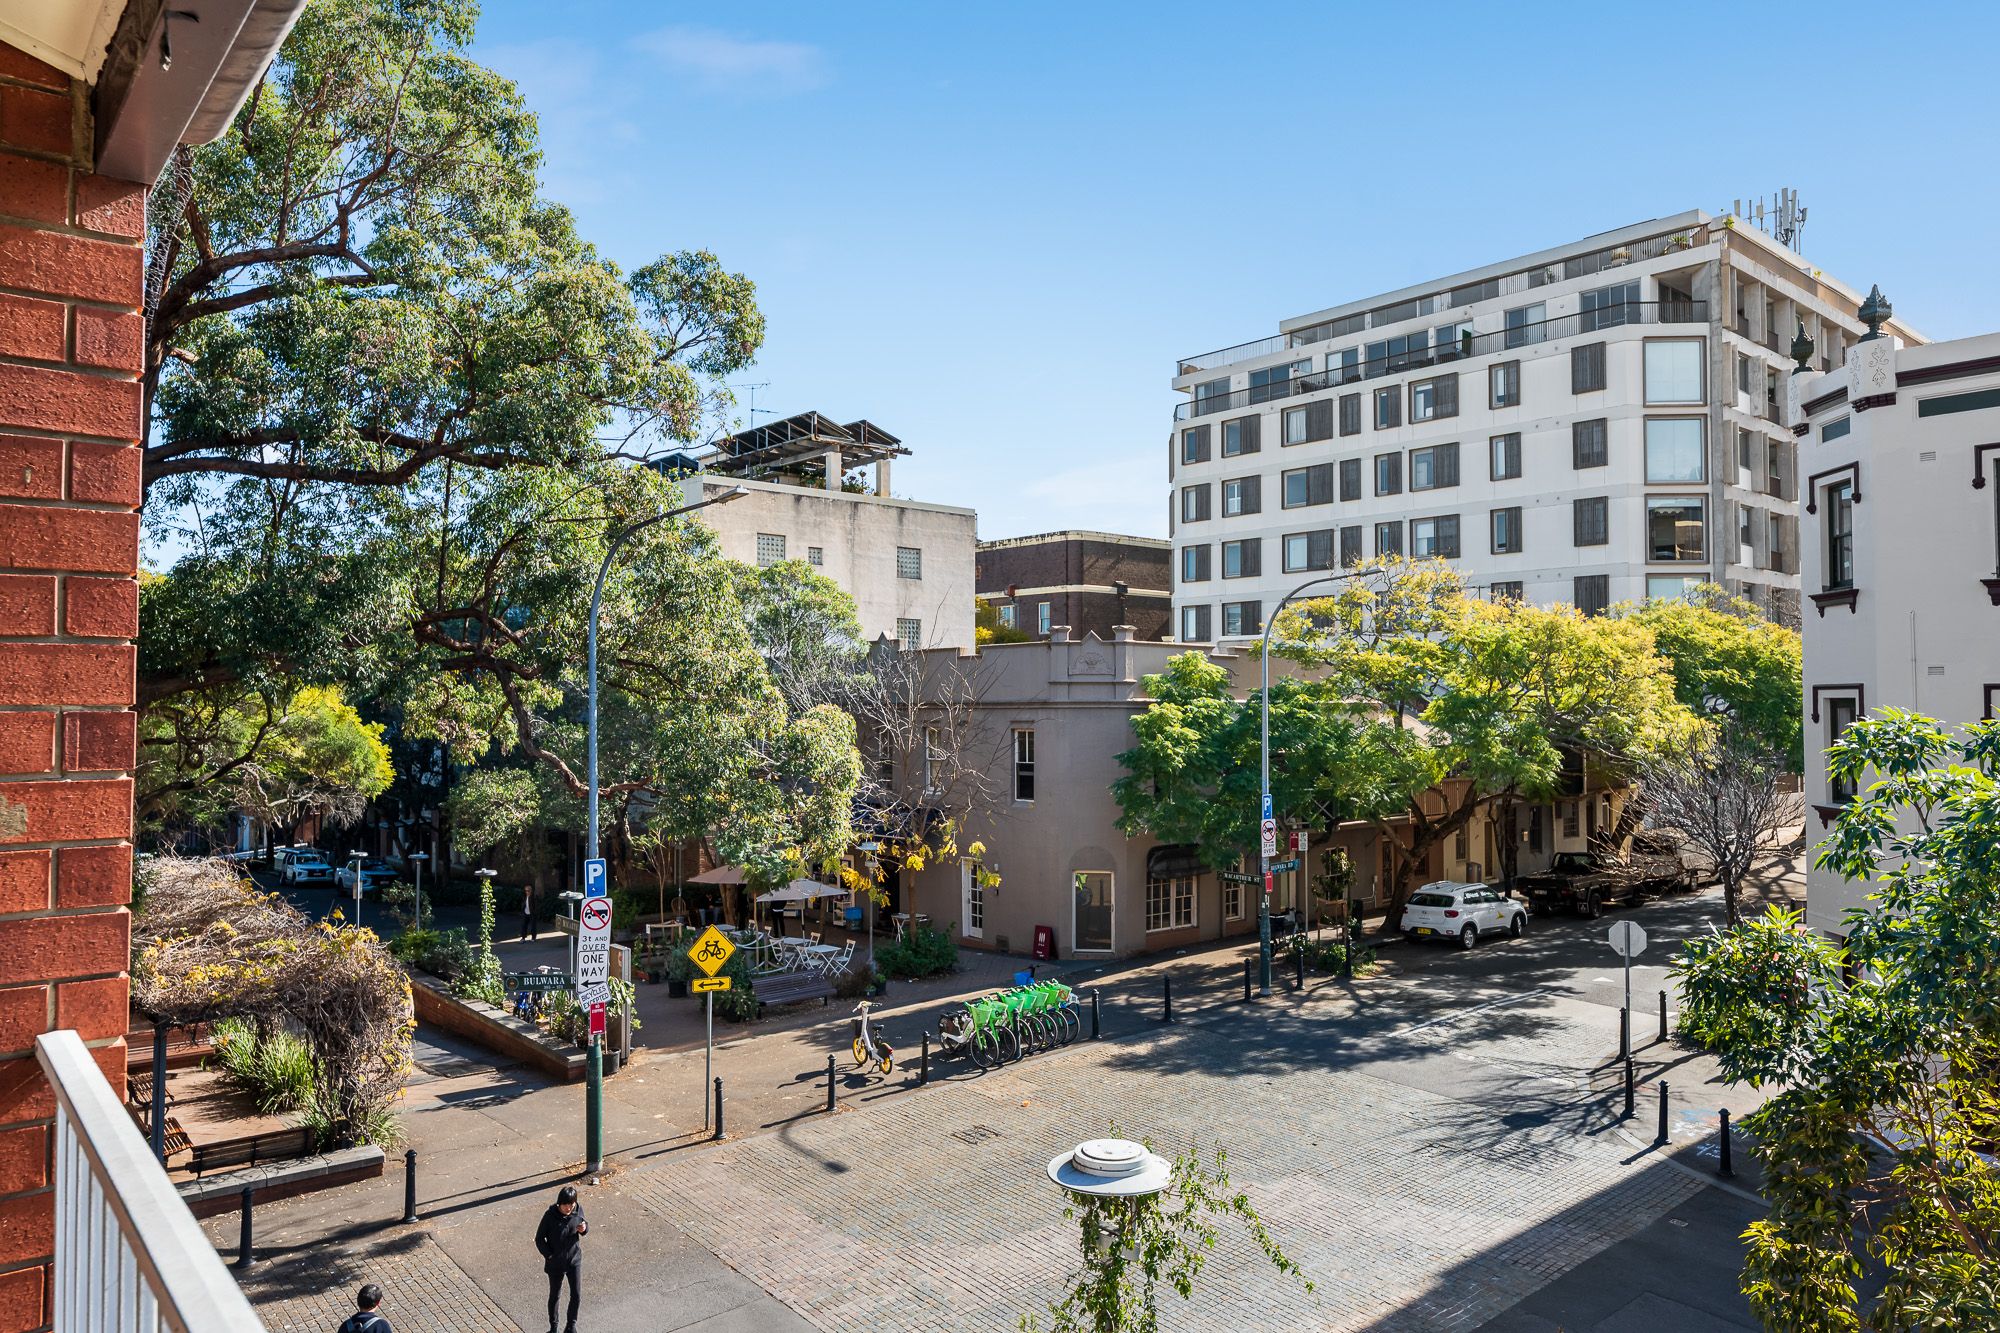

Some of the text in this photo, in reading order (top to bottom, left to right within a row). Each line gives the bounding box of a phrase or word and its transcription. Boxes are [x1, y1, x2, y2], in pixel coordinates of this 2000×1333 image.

[1264, 797, 1271, 810] P
[588, 863, 603, 884] P
[583, 954, 604, 964] ONE
[581, 967, 605, 977] WAY
[523, 977, 565, 985] BULWARA
[581, 985, 607, 1002] BICYCLES
